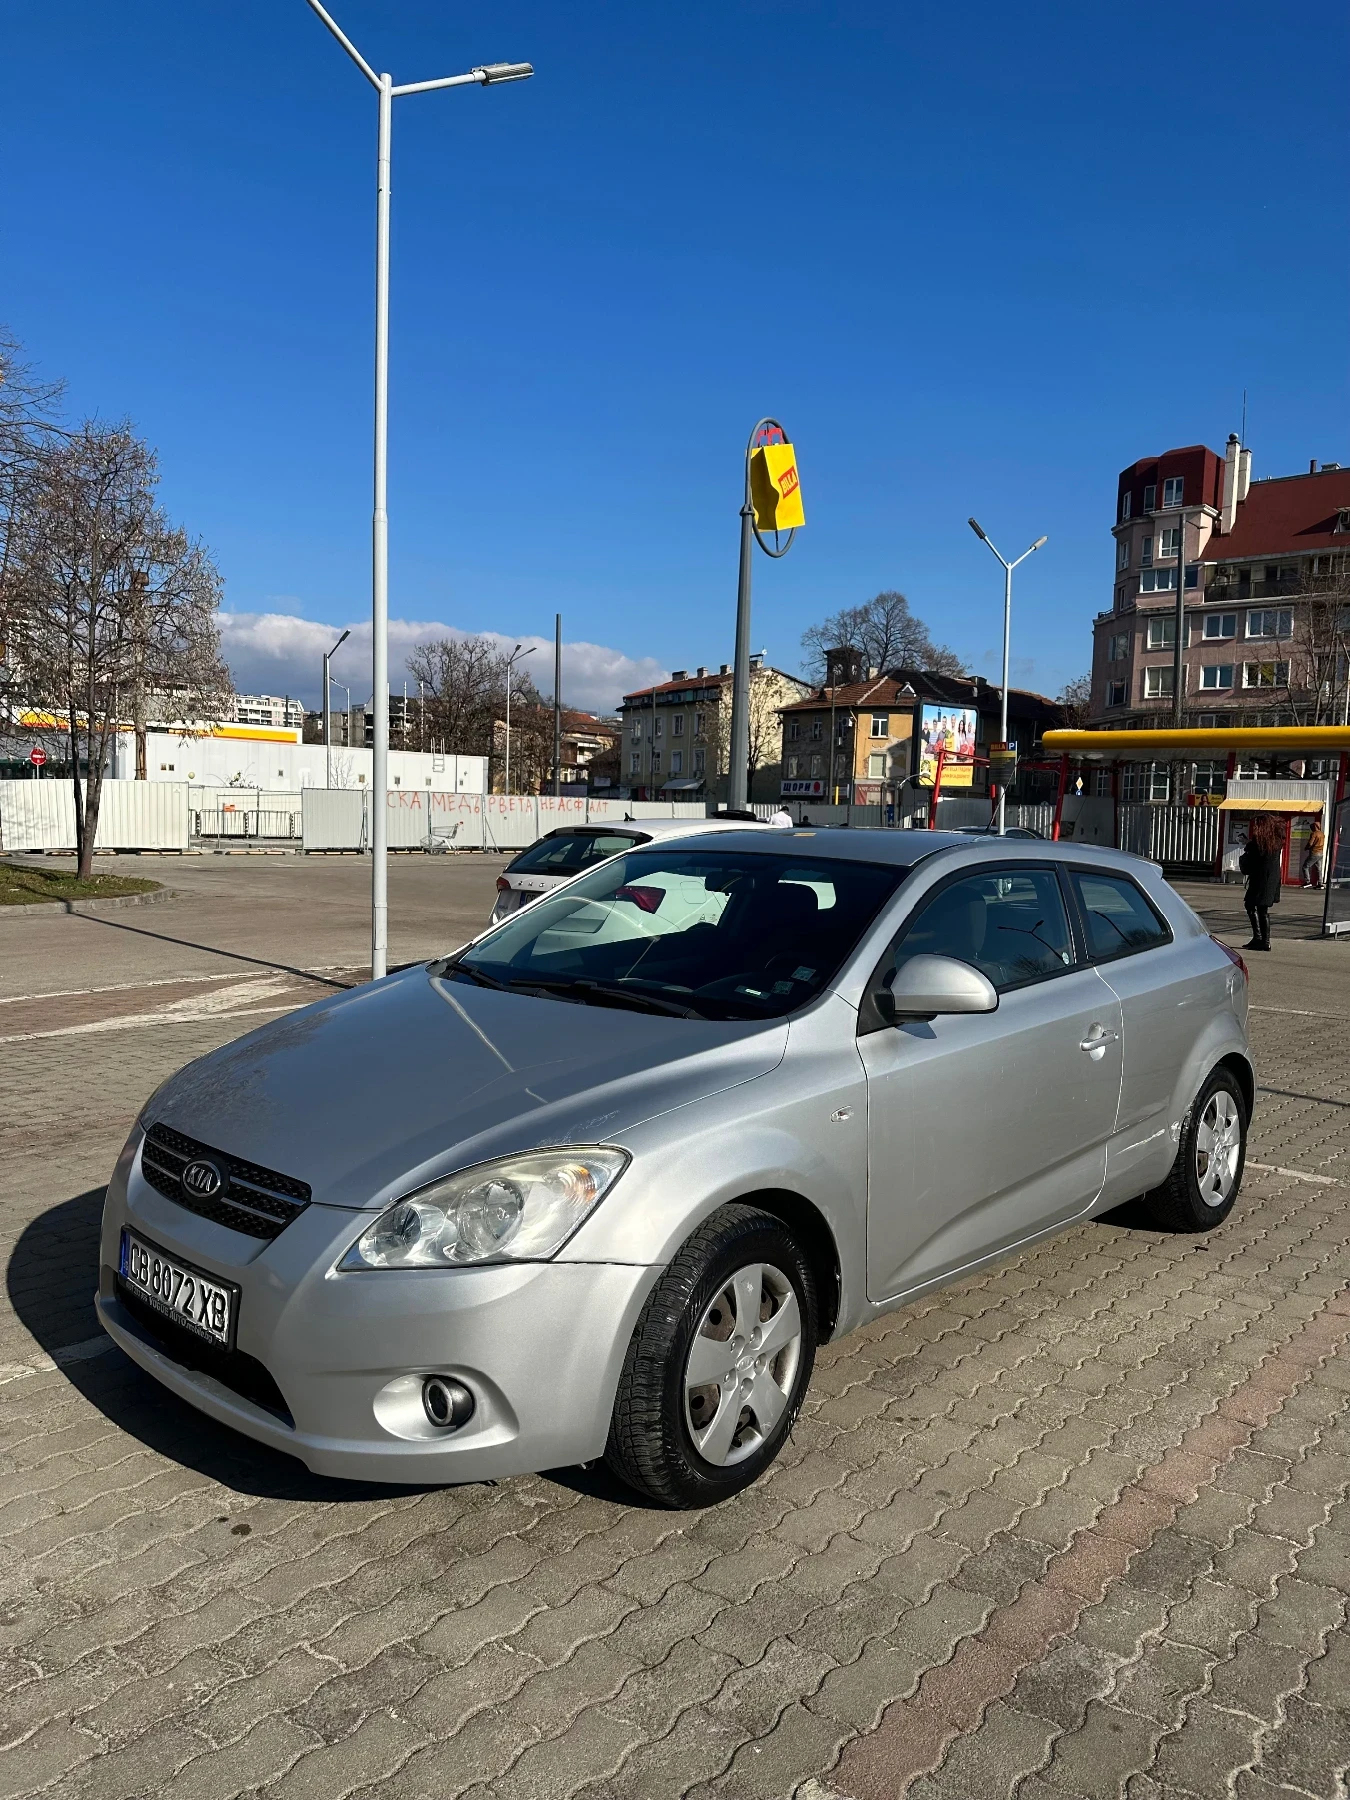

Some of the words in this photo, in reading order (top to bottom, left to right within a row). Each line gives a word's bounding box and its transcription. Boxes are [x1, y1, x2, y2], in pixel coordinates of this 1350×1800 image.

[780, 470, 798, 495] BILLA
[1008, 742, 1015, 750] P
[782, 782, 811, 791] ЩОРИ
[186, 1165, 213, 1192] KIA
